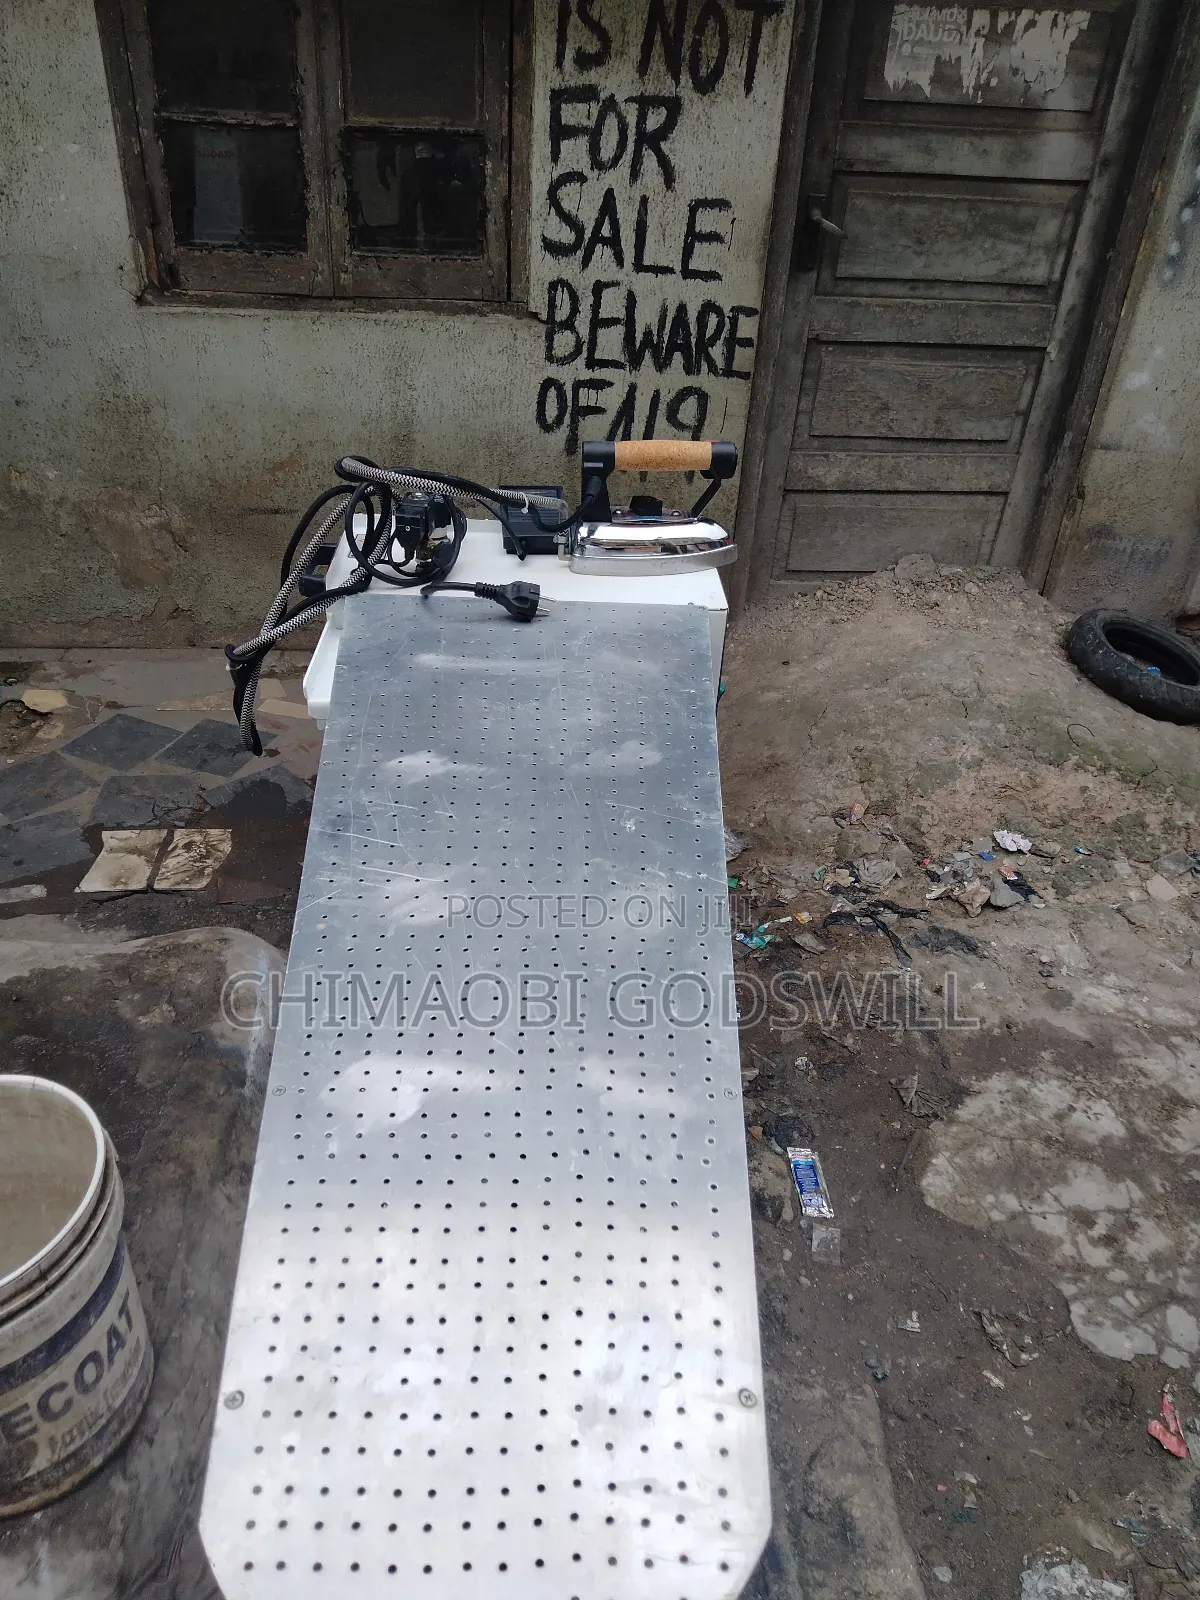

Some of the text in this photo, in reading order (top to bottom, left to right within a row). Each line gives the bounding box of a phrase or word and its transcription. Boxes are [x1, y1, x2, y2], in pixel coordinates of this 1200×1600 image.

[554, 0, 785, 97] IS NOT
[549, 84, 684, 191] FOR
[541, 171, 733, 281] SALE
[544, 278, 760, 379] BEWARE
[535, 378, 613, 455] OF
